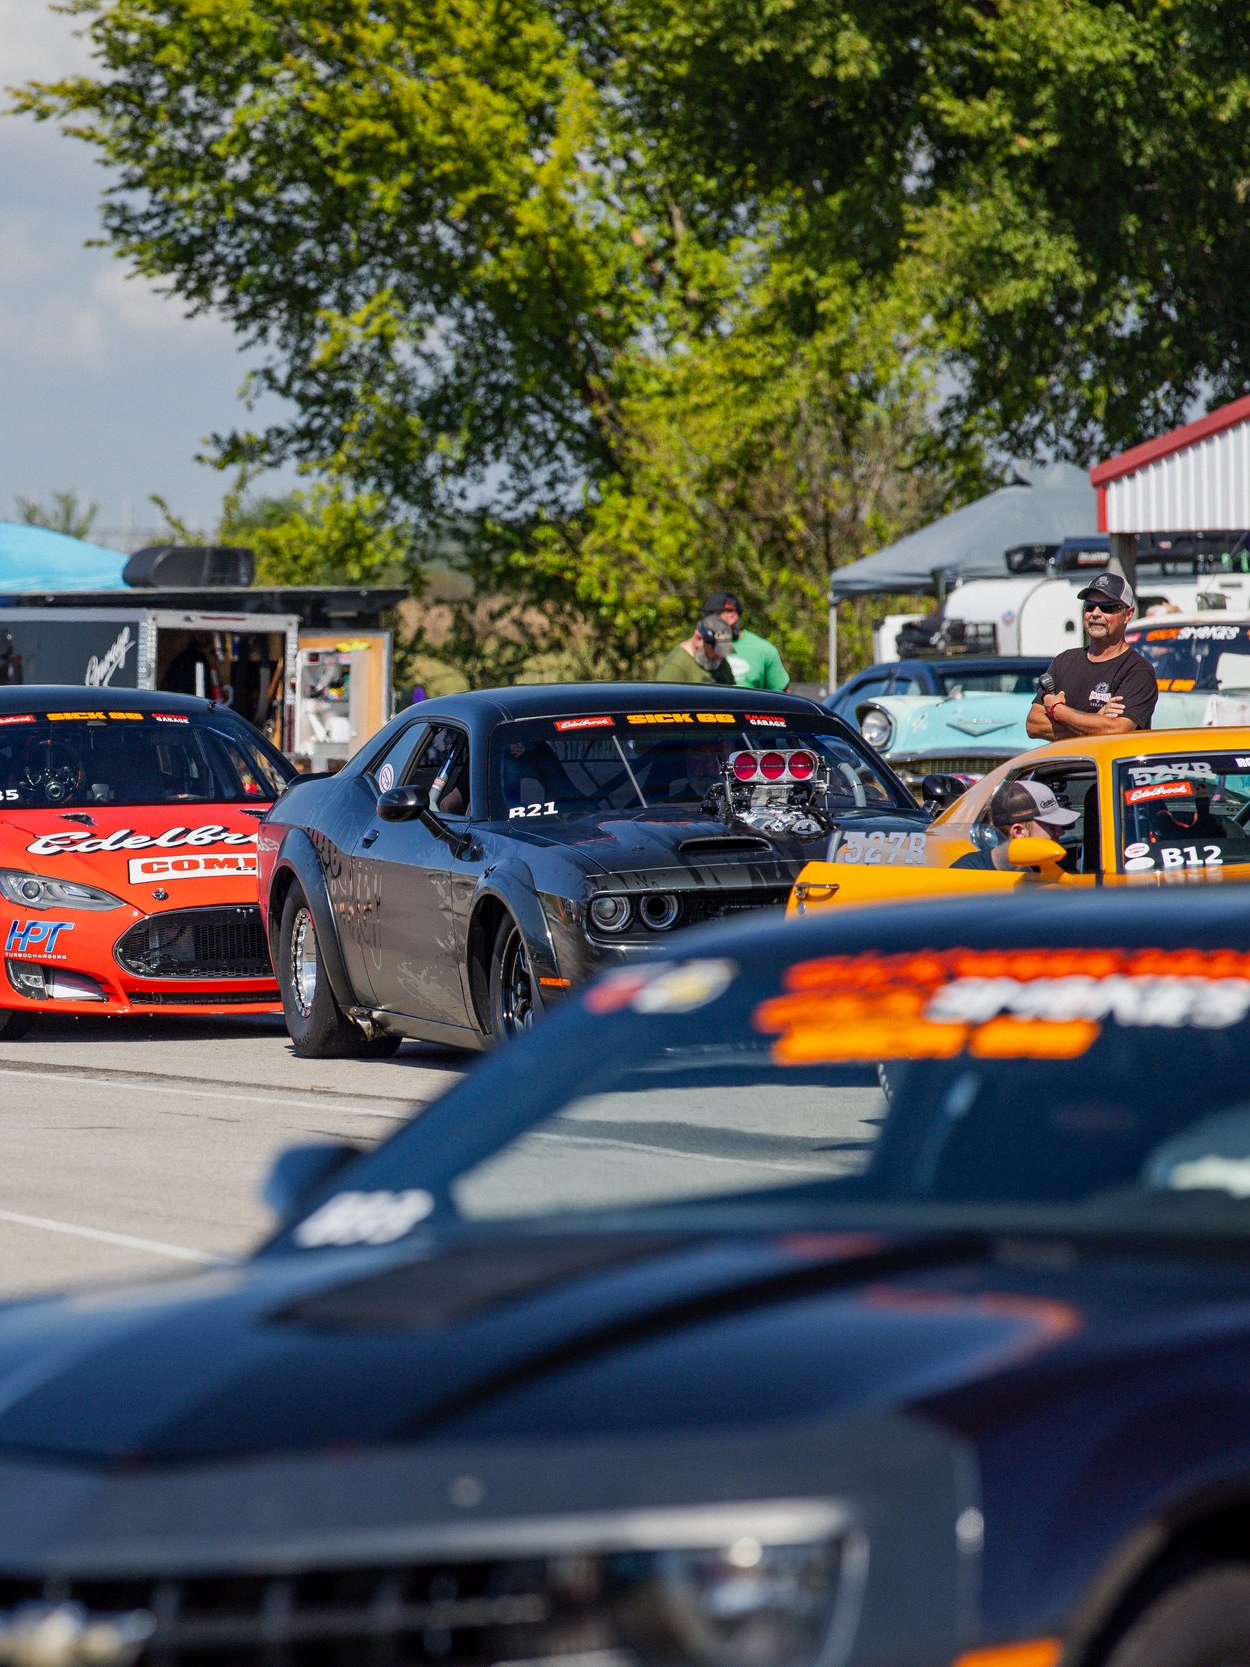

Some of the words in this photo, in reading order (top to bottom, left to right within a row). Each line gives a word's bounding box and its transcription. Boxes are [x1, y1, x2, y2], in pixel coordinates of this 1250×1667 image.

[46, 711, 107, 721] SICK
[626, 713, 694, 725] SICK
[560, 717, 610, 729] Edelbrock
[750, 719, 787, 728] GARAGE
[1130, 785, 1188, 801] Edelbrock
[1161, 845, 1223, 869] B12
[5, 920, 76, 953] HPT
[4, 952, 67, 960] TURBOCHARGERS
